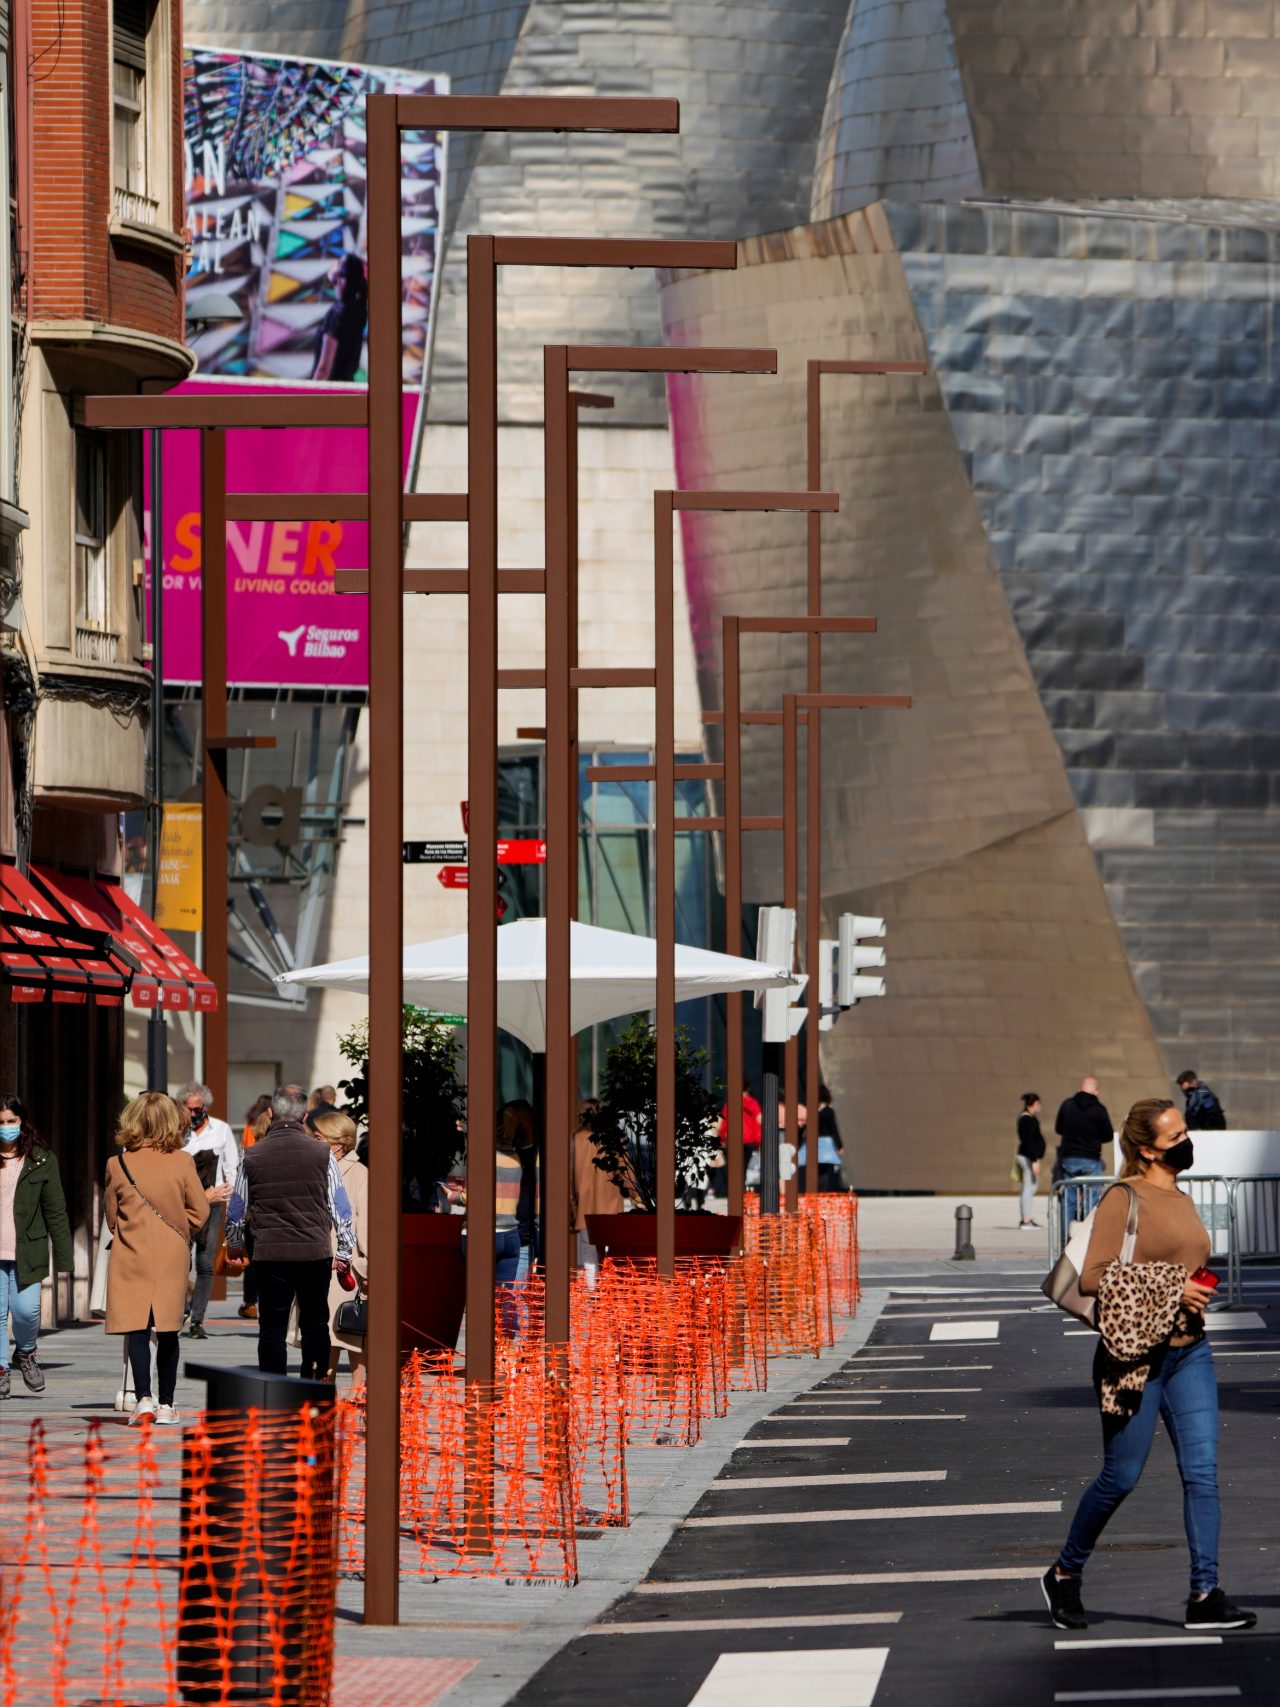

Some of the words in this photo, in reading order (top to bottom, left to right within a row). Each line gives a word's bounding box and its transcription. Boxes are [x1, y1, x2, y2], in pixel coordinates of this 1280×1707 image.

[143, 511, 344, 577] SNER
[235, 577, 286, 595] LIVING
[306, 624, 359, 643] Seguros
[303, 640, 347, 659] Bilbao
